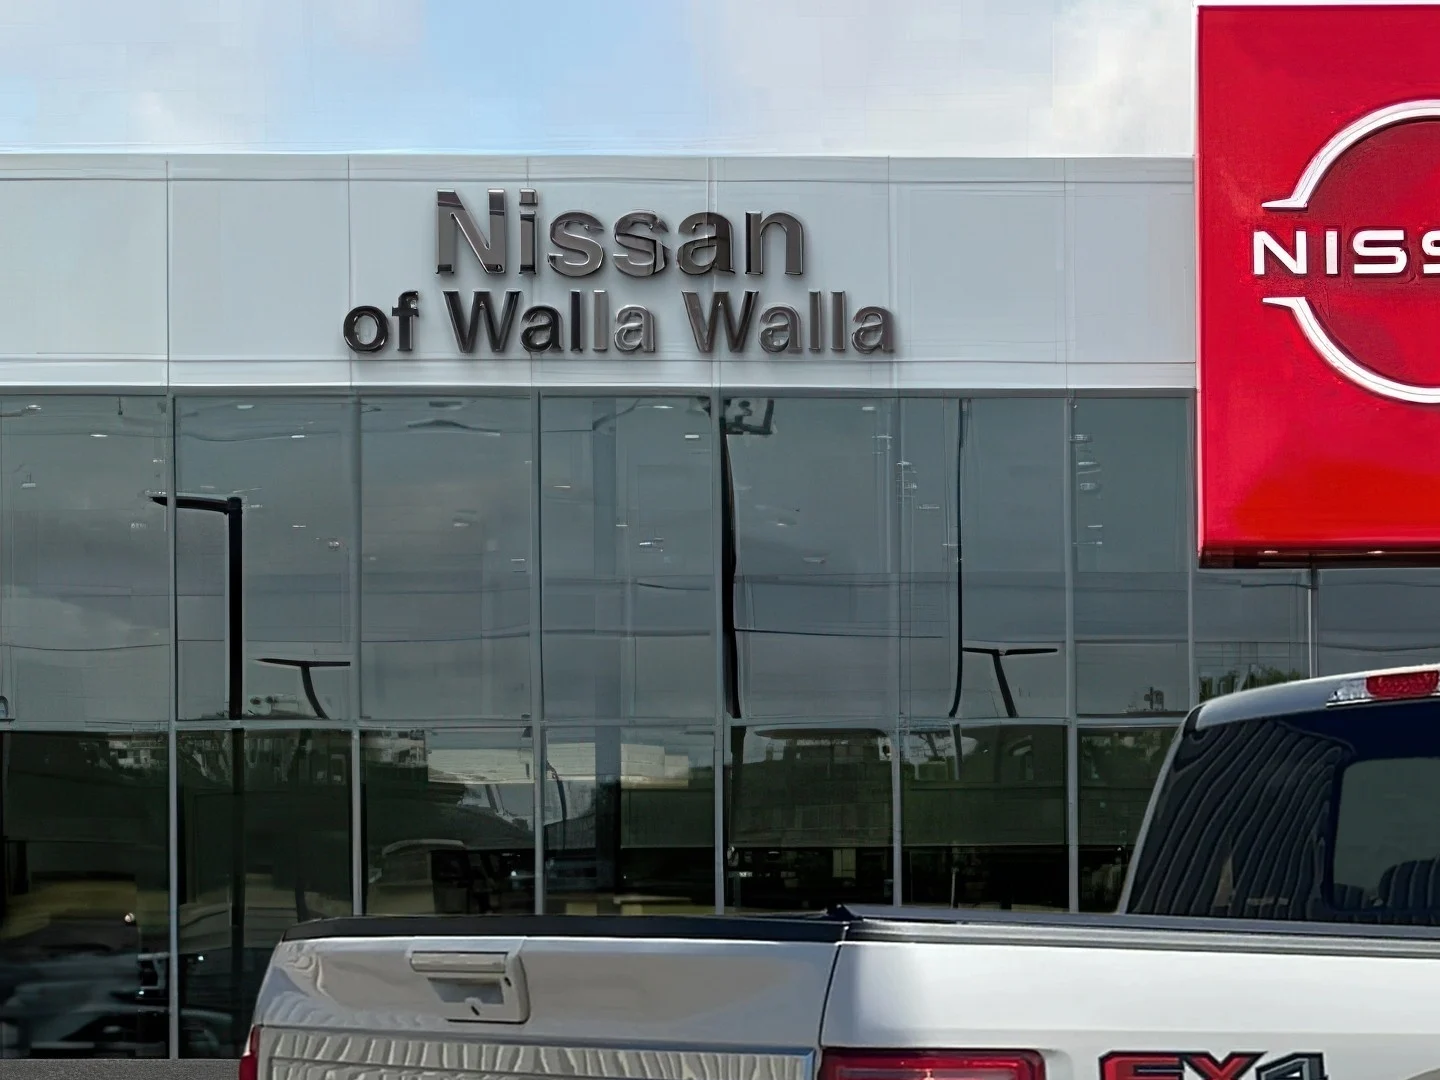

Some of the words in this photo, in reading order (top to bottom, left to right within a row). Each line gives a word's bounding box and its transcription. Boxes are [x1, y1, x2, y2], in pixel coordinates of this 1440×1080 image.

[435, 188, 807, 276] Nissan
[342, 290, 419, 354] of
[442, 290, 657, 354] Walla
[680, 290, 895, 354] Walla
